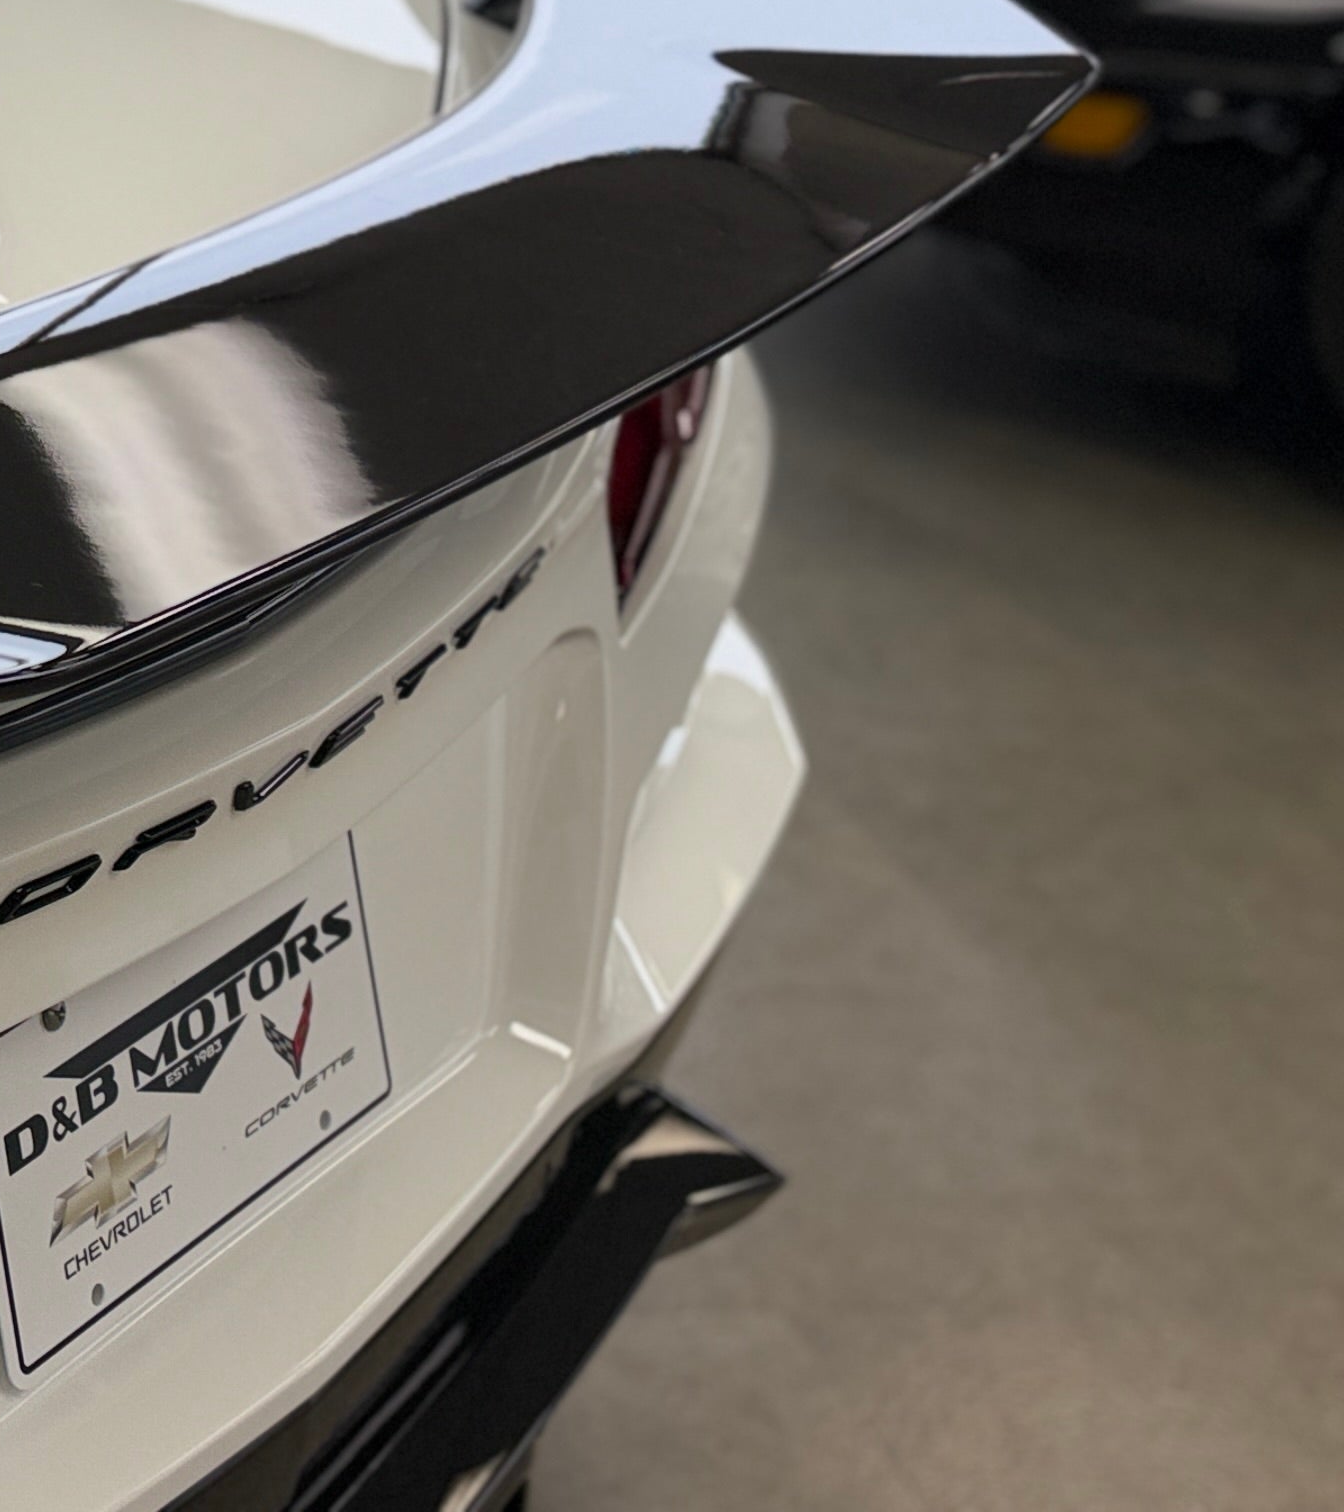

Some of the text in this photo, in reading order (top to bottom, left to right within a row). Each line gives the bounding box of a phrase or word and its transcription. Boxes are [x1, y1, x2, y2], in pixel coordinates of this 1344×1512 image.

[3, 900, 352, 1176] D&B MOTORS
[165, 1038, 223, 1087] EST. 1983
[244, 1046, 355, 1138] CORVETTE
[63, 1184, 173, 1280] CHEVROLET
